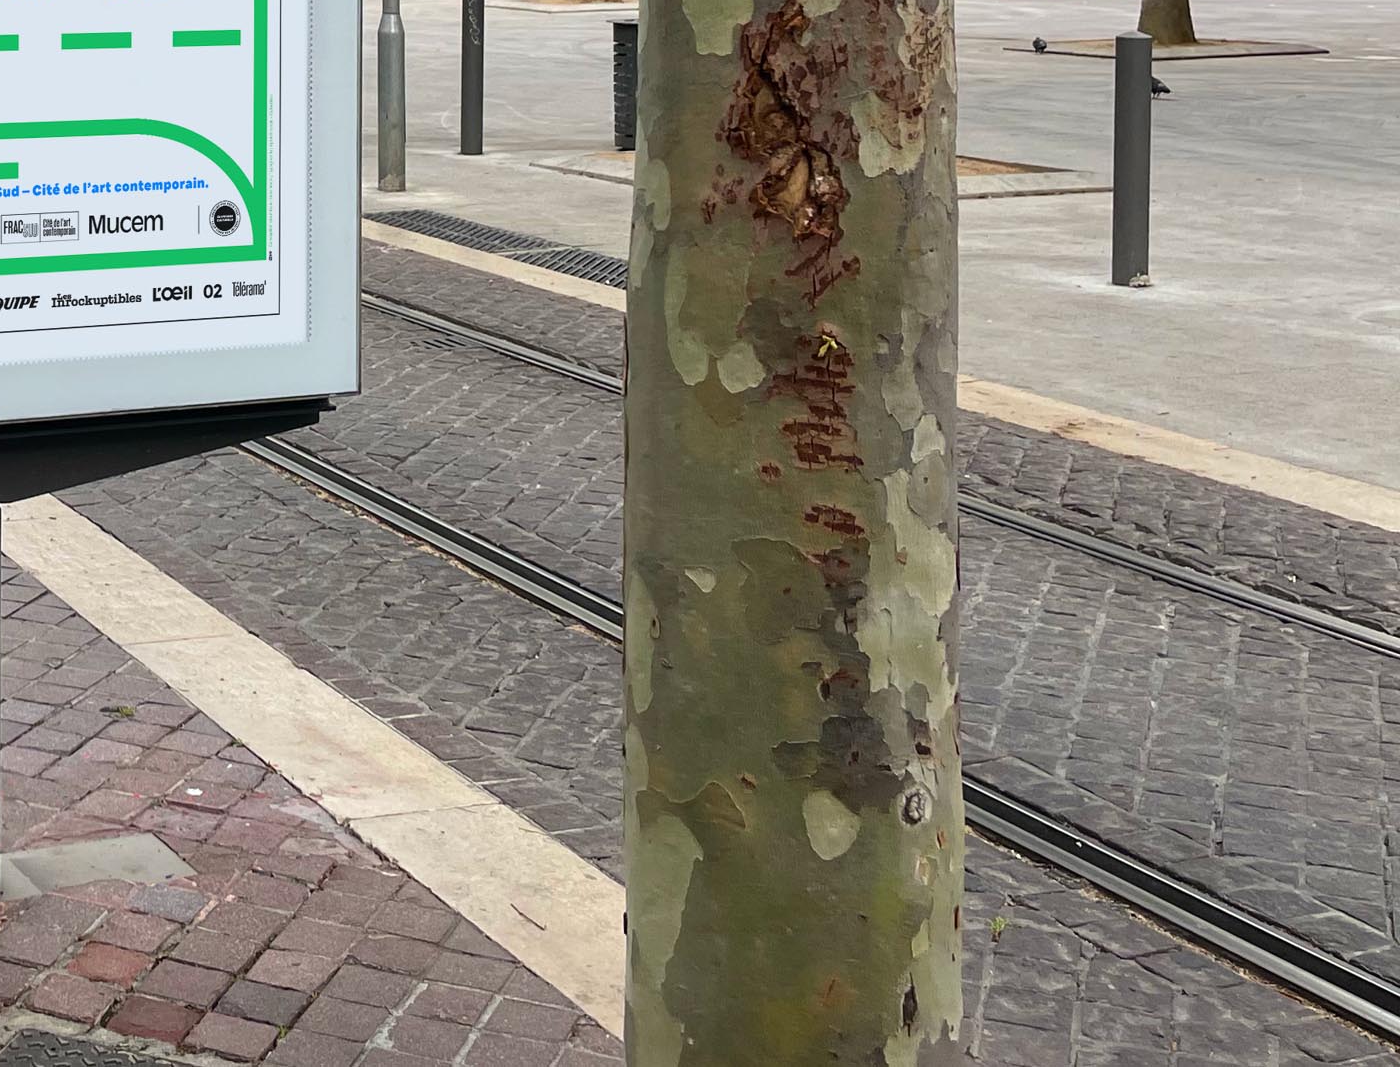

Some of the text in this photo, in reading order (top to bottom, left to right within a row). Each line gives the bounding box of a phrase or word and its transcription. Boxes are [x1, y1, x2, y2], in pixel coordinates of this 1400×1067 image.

[33, 183, 60, 196] Cité
[64, 183, 79, 194] de
[83, 182, 111, 193] l'art
[115, 178, 208, 193] contemporain.
[4, 220, 24, 235] FRAC
[53, 219, 60, 227] de
[89, 214, 163, 234] Mucem
[42, 226, 76, 237] contemporain
[51, 293, 142, 308] Inrockuptibles
